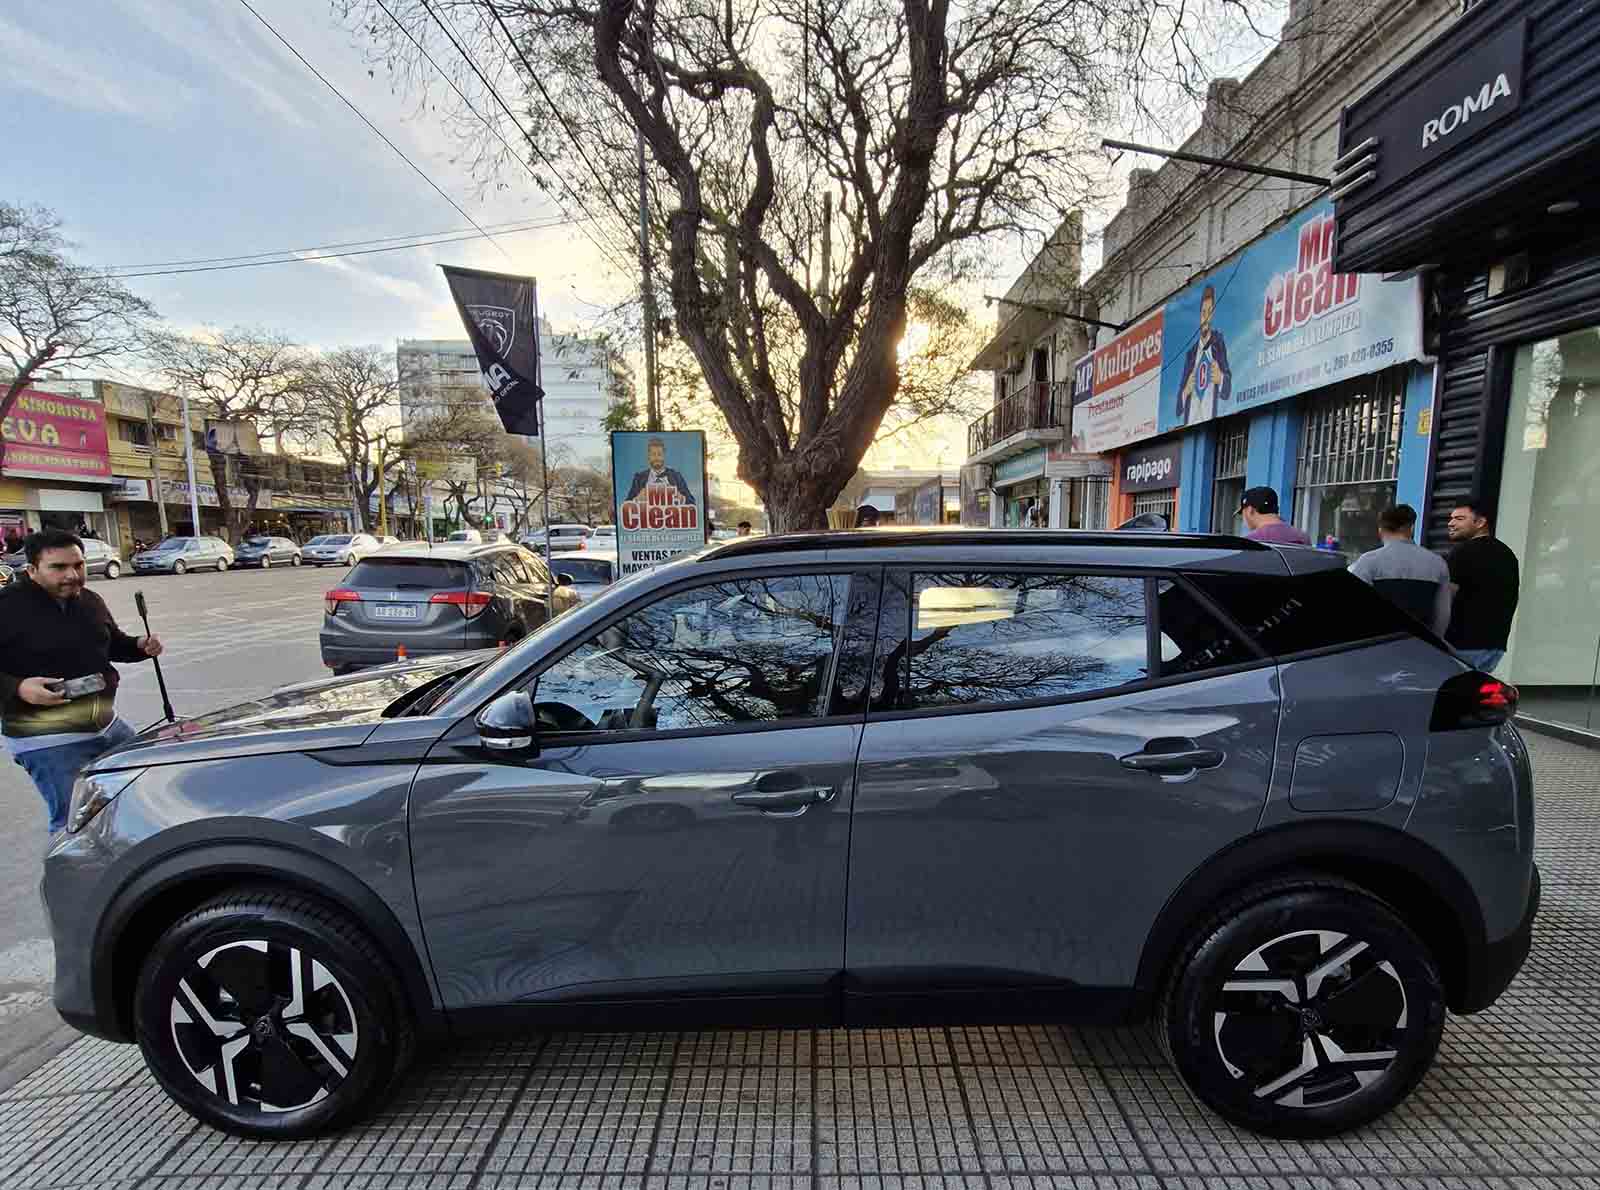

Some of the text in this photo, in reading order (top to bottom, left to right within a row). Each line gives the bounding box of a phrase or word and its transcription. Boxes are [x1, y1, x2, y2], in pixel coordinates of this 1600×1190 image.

[1422, 72, 1511, 149] ROMA
[1075, 330, 1162, 395] MP Multipres
[1126, 457, 1171, 484] rapipago
[622, 501, 697, 530] Clean
[632, 550, 668, 561] VENTAS
